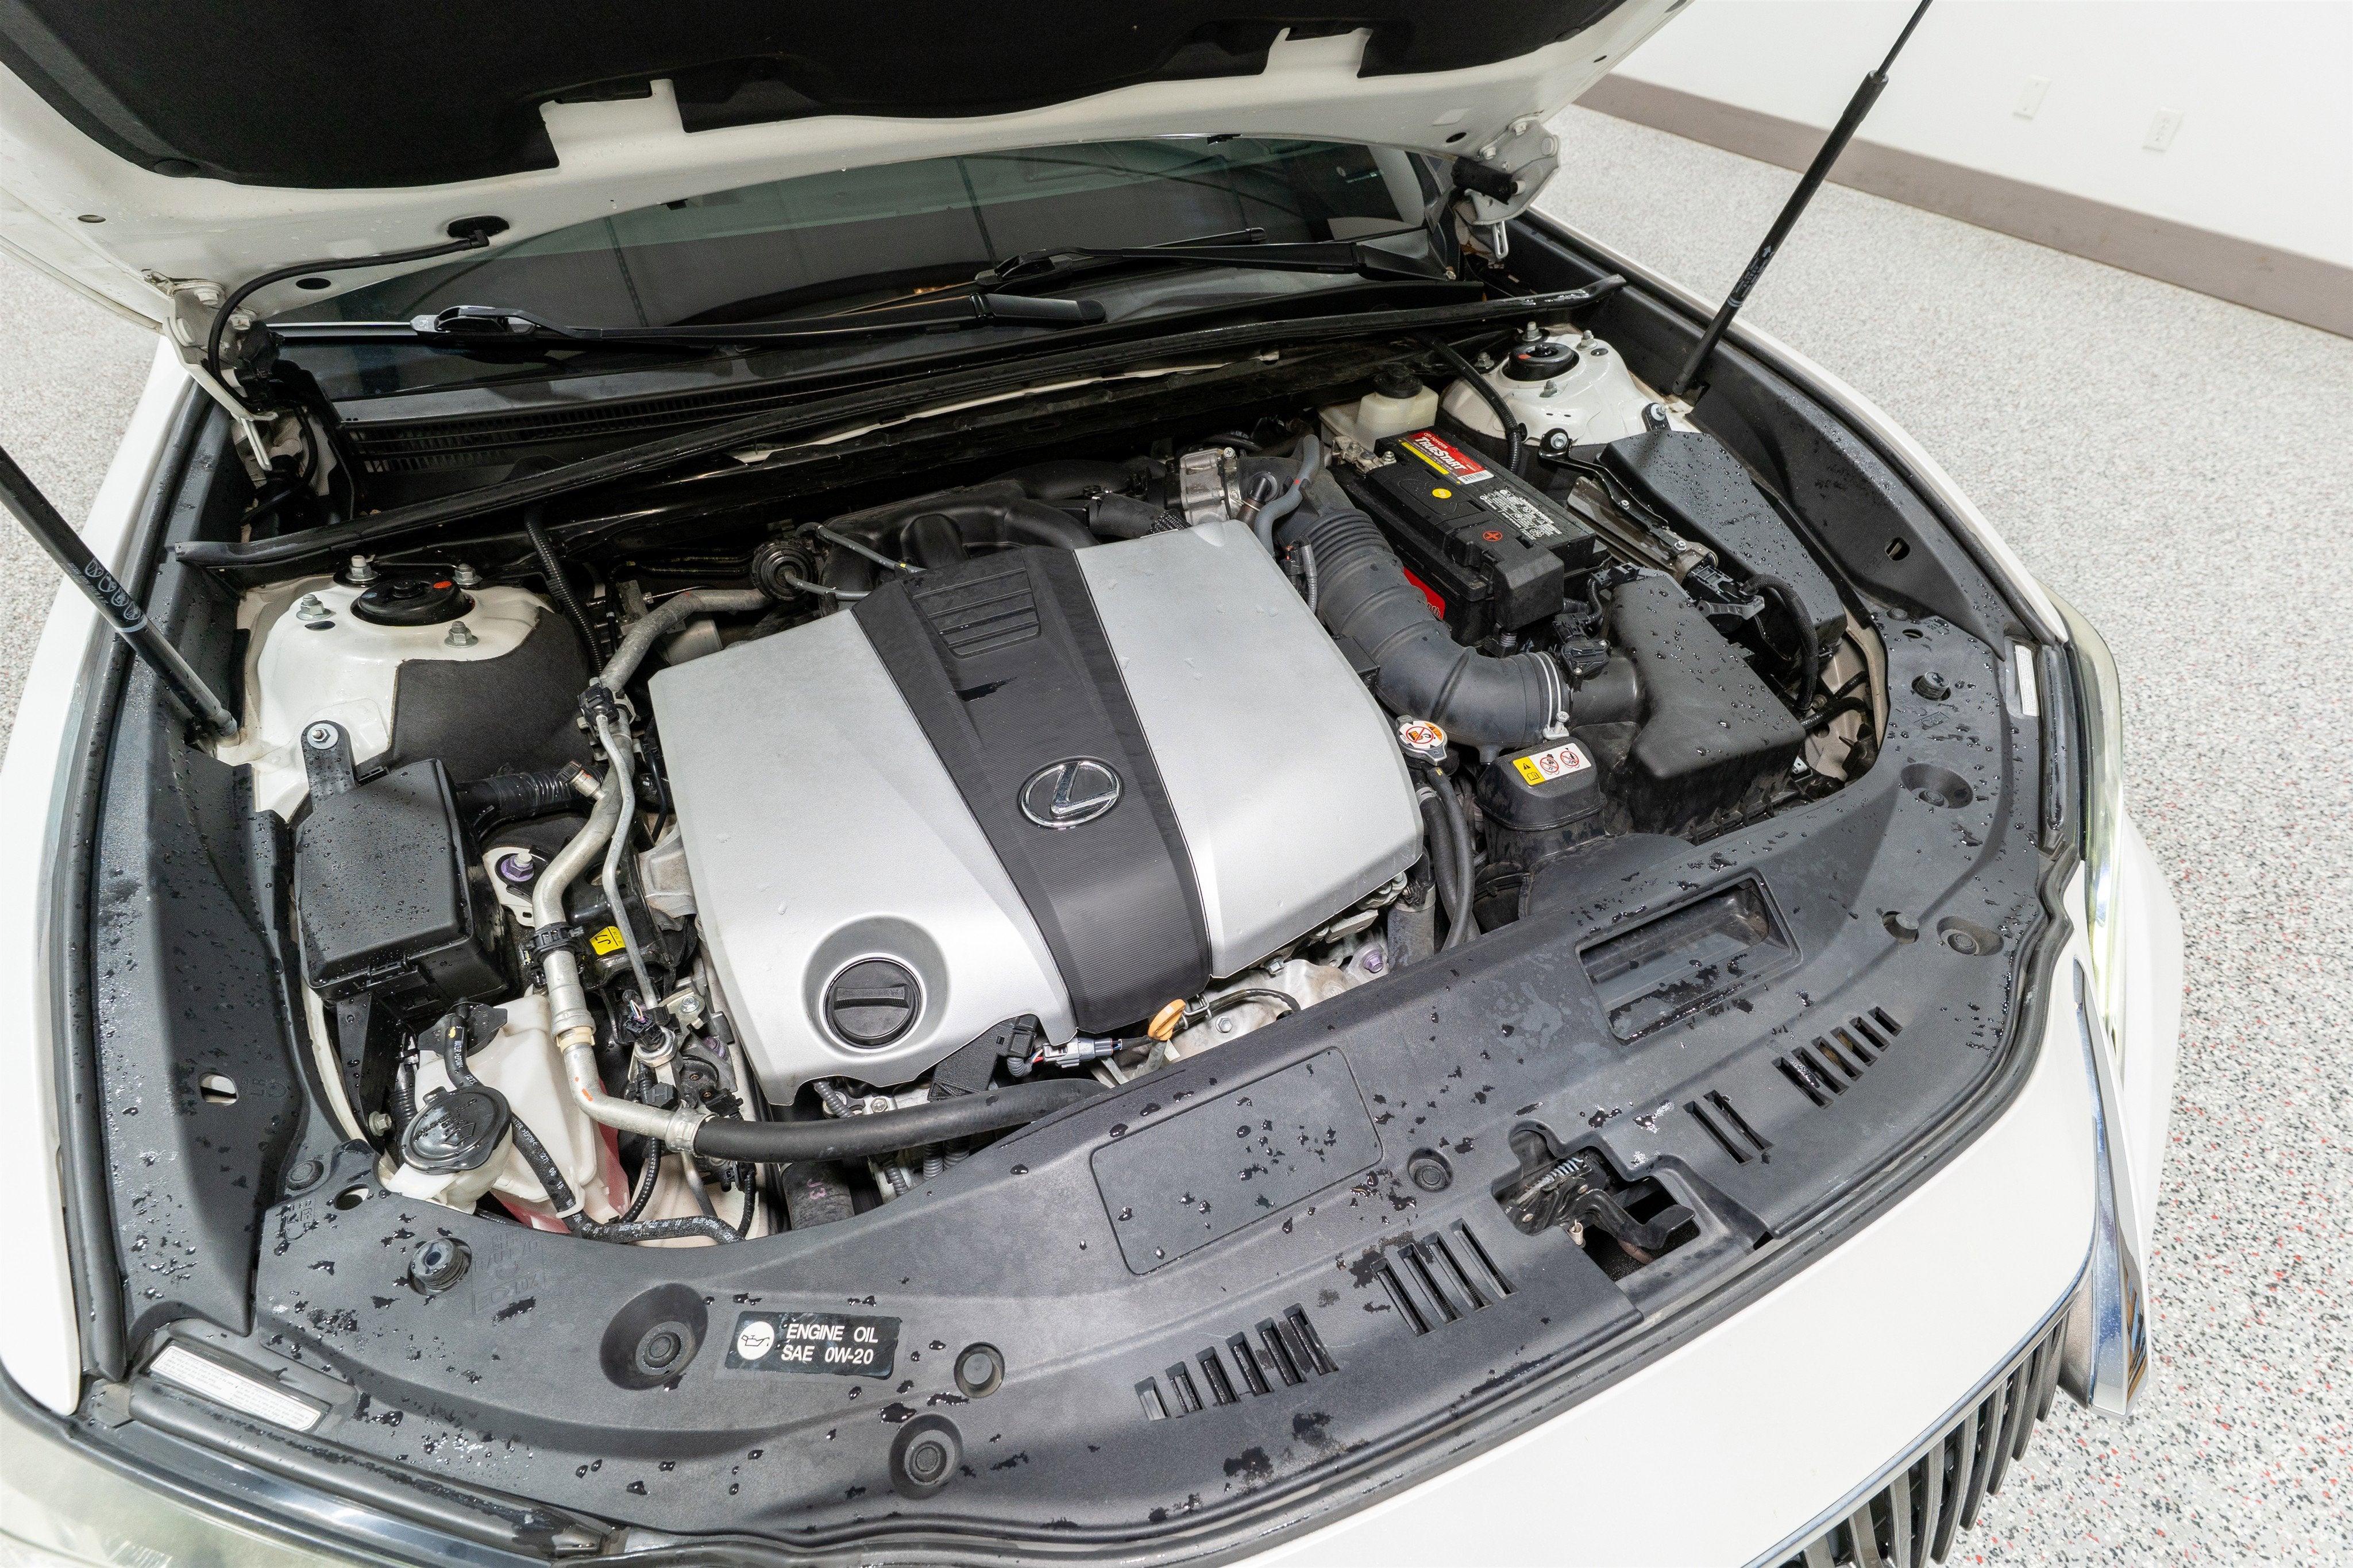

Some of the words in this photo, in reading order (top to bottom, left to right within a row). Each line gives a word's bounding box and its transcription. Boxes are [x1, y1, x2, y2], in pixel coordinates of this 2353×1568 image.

[1430, 437, 1448, 449] TOYOTA
[651, 1085, 668, 1103] H
[549, 1167, 557, 1176] 06
[556, 1181, 564, 1189] 18
[786, 1323, 844, 1341] ENGINE
[854, 1326, 878, 1343] OIL
[781, 1345, 815, 1361] SAE
[824, 1347, 874, 1364] 0W-20
